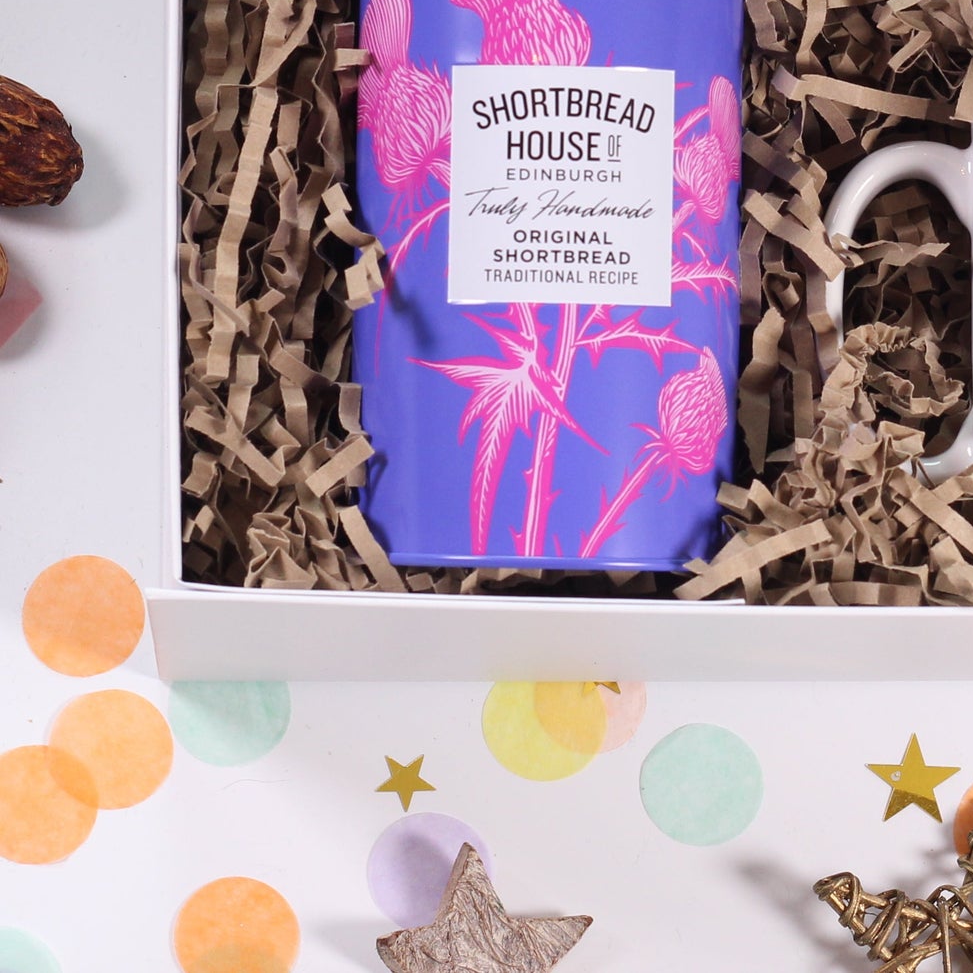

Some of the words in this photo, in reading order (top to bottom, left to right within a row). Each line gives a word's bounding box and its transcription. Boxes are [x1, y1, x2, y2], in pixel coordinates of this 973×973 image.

[472, 87, 656, 134] SHORTBREAD
[507, 130, 601, 161] HOUSE
[607, 134, 622, 159] OF
[506, 168, 622, 183] EDINBURGH
[464, 187, 529, 225] Truly
[532, 189, 655, 220] Handmade
[513, 230, 613, 245] ORIGINAL
[493, 249, 631, 265] SHORTBREAD
[484, 269, 584, 283] TRADITIONAL
[589, 271, 639, 285] RECIPE
